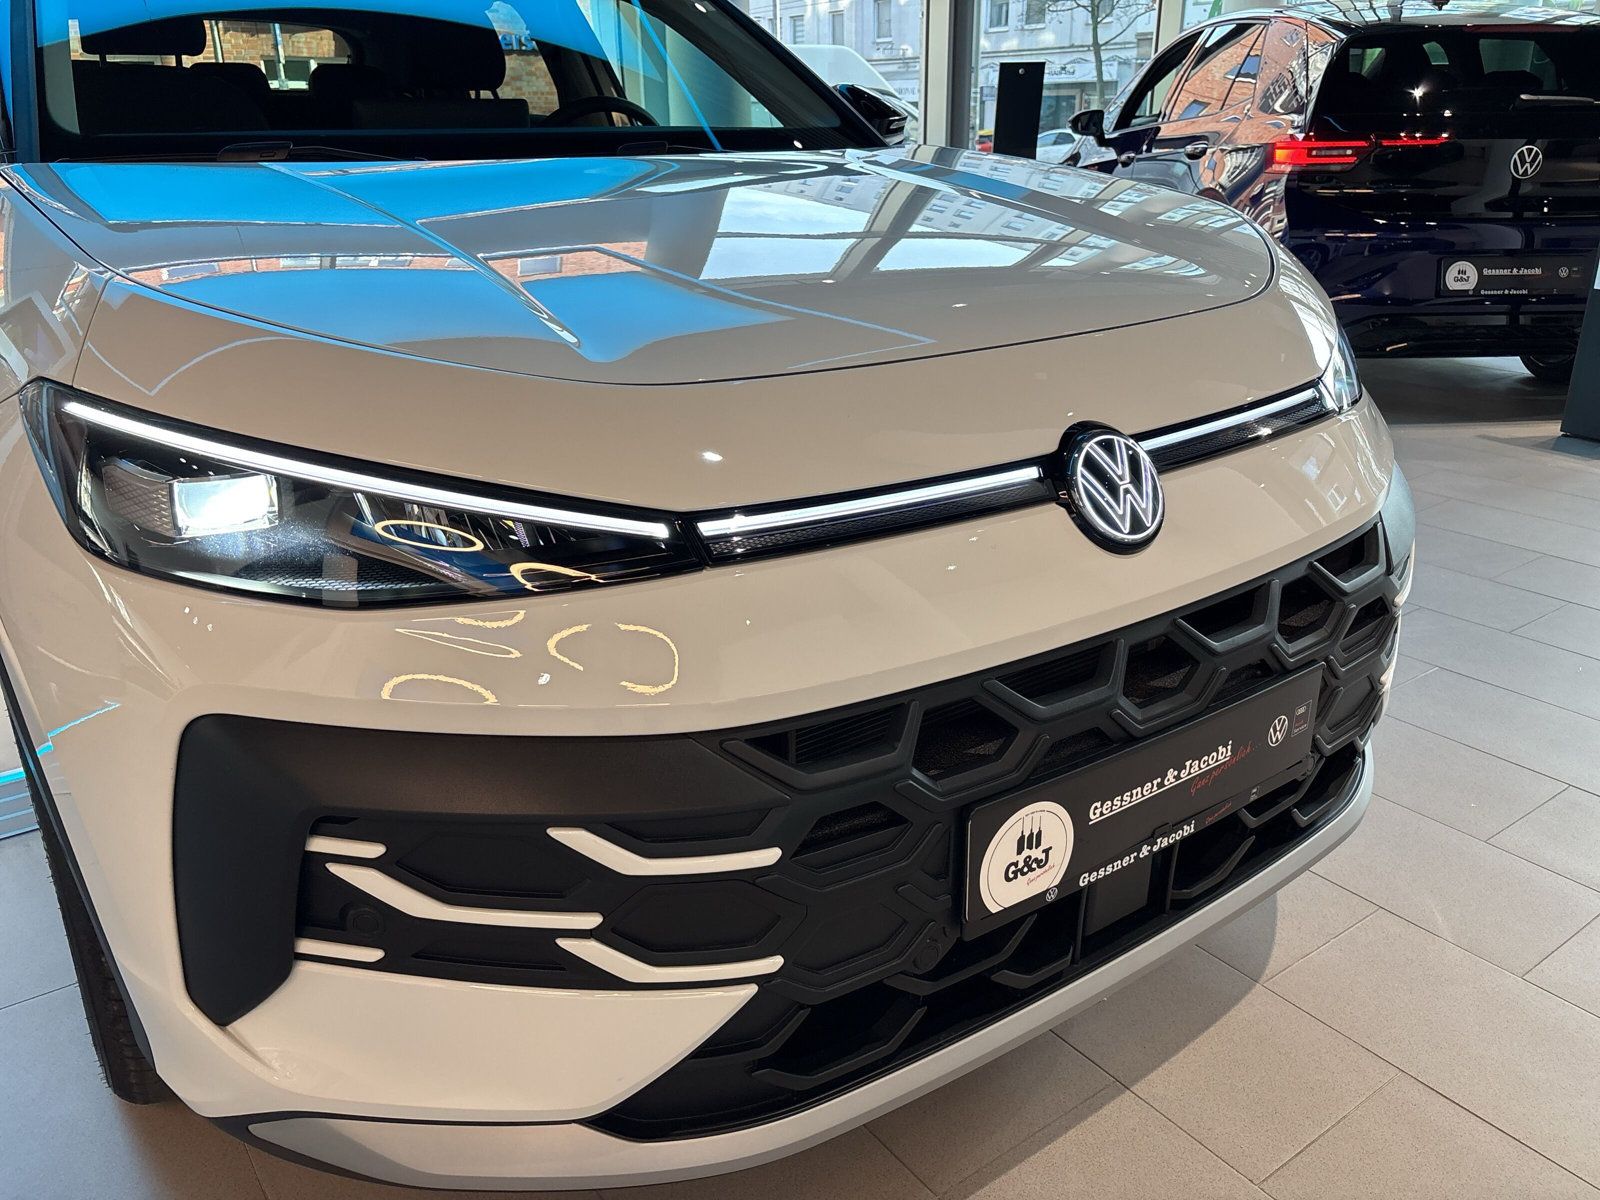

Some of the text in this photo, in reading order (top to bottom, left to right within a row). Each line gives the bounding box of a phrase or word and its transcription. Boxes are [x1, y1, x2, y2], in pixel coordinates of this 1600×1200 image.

[1482, 266, 1542, 276] Gessner & Jacobi
[1088, 777, 1162, 821] Gessner
[1163, 768, 1179, 787] &
[1180, 740, 1233, 778] Jacobi
[1004, 846, 1053, 883] G&J
[1078, 851, 1138, 887] Gessner
[1139, 844, 1152, 858] &
[1152, 820, 1196, 852] Jacobi
